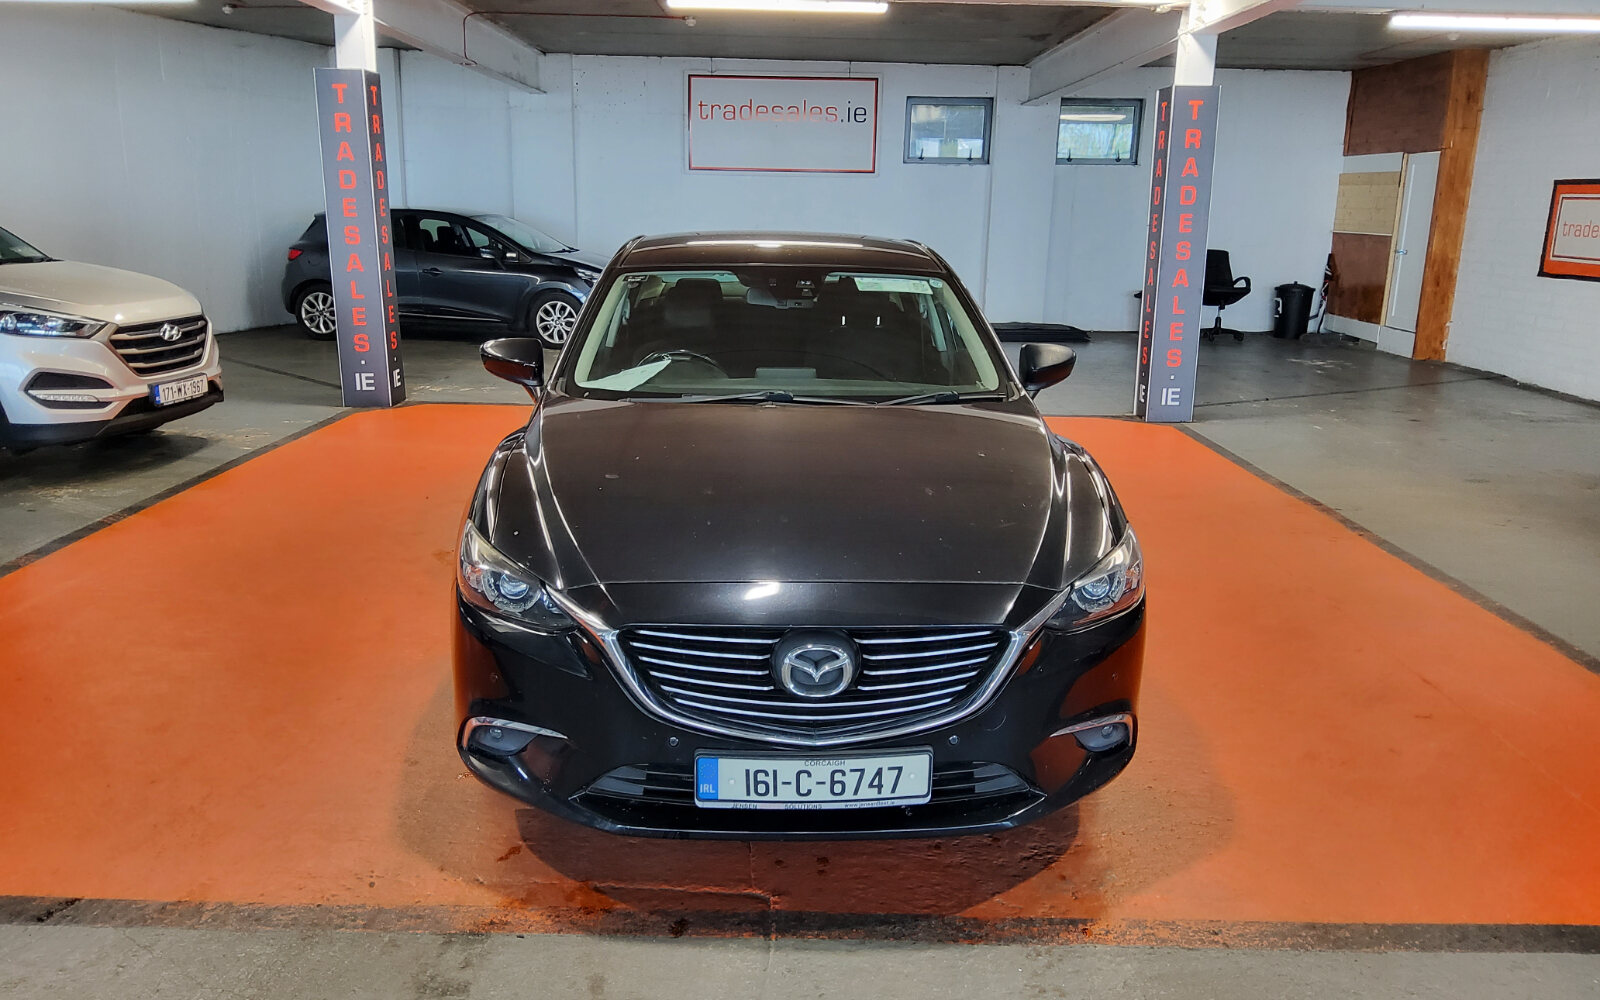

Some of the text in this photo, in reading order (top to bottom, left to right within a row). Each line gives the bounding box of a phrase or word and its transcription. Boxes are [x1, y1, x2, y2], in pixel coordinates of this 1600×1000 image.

[698, 98, 867, 123] tradesales.ie
[1562, 220, 1600, 238] trade
[162, 380, 204, 401] 171-WX-1967
[700, 784, 716, 793] IRL
[745, 766, 904, 797] 161-C-6747
